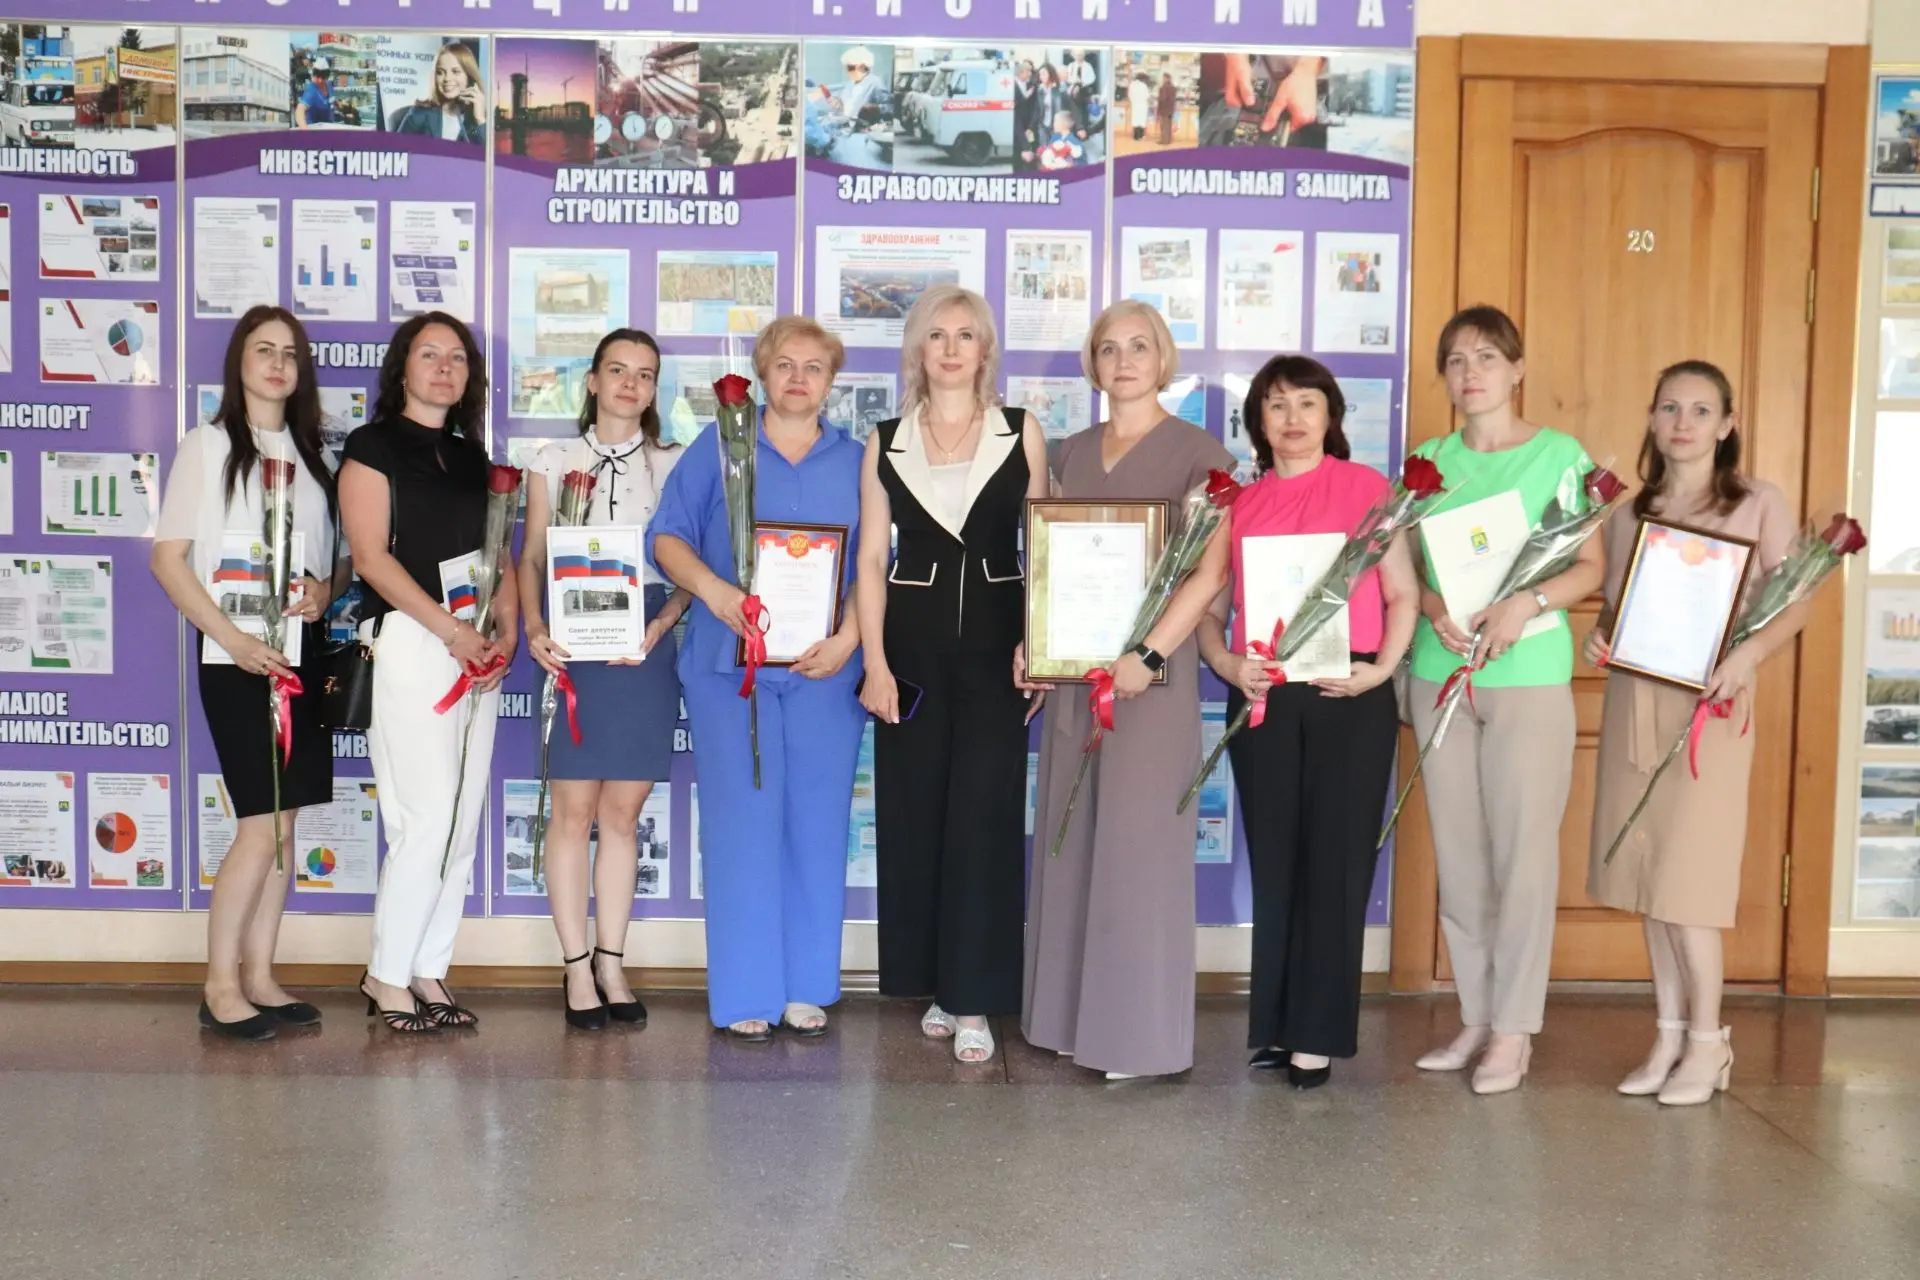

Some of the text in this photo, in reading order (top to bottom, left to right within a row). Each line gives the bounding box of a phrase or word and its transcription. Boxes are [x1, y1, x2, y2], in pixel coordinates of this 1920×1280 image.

[259, 149, 409, 178] ИНВЕСТИЦИИ
[555, 168, 734, 196] АРХИТЕКТУРА И
[838, 174, 1060, 204] ЗДРАВООХРАНЕНИЕ
[1130, 168, 1391, 202] СОЦИАЛЬНАЯ ЗАЩИТА
[548, 198, 740, 226] СТРОИТЕЛЬСТВО
[1627, 229, 1655, 253] 20
